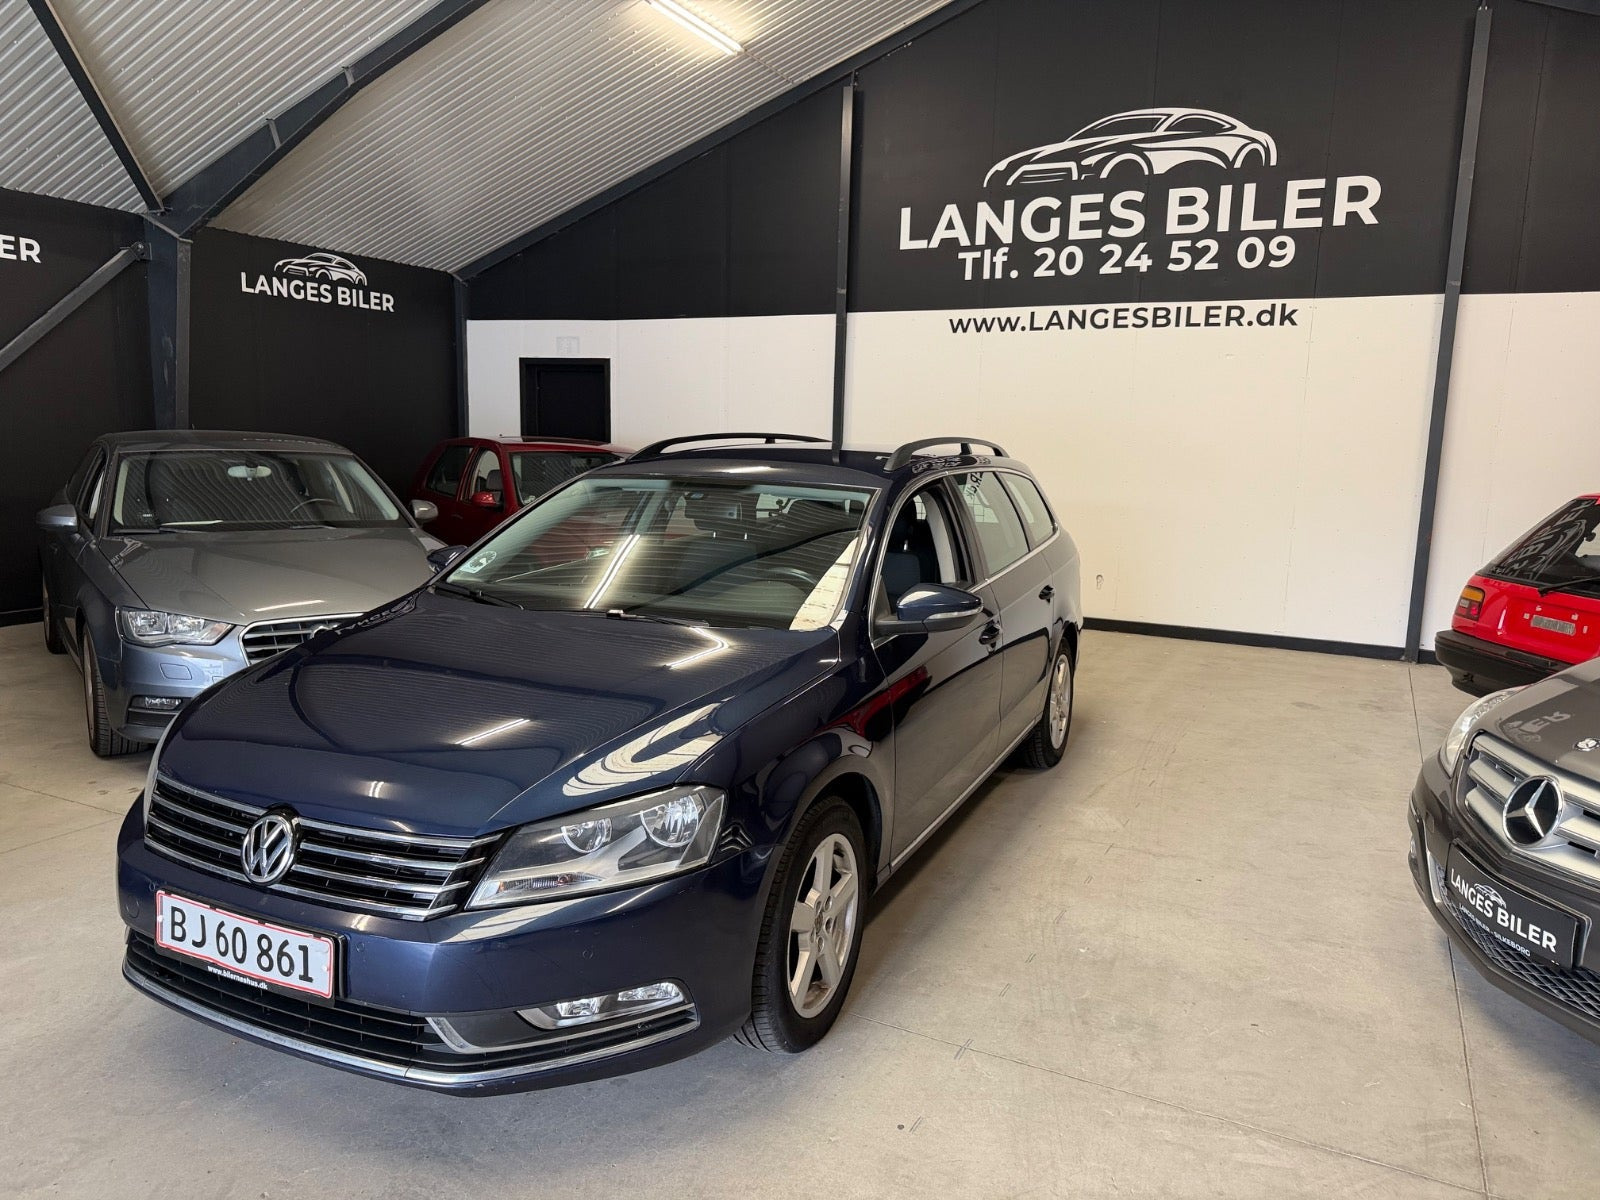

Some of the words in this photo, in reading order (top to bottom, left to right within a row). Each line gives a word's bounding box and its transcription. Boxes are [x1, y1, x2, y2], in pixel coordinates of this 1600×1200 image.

[900, 190, 1146, 251] LANGES
[1165, 175, 1382, 235] BILER
[957, 246, 1019, 281] Tlf.
[1033, 245, 1084, 278] 20
[1099, 241, 1153, 275] 24
[1166, 238, 1219, 272] 52
[1236, 235, 1296, 269] 09
[240, 271, 333, 304] LANGES
[337, 286, 395, 313] BILER
[949, 303, 1298, 334] www.LANGESBILER.dk
[1451, 868, 1494, 918] LANGES
[1496, 907, 1557, 953] BILER
[171, 905, 207, 949] BJ
[215, 920, 247, 964] 60
[256, 933, 314, 983] 861
